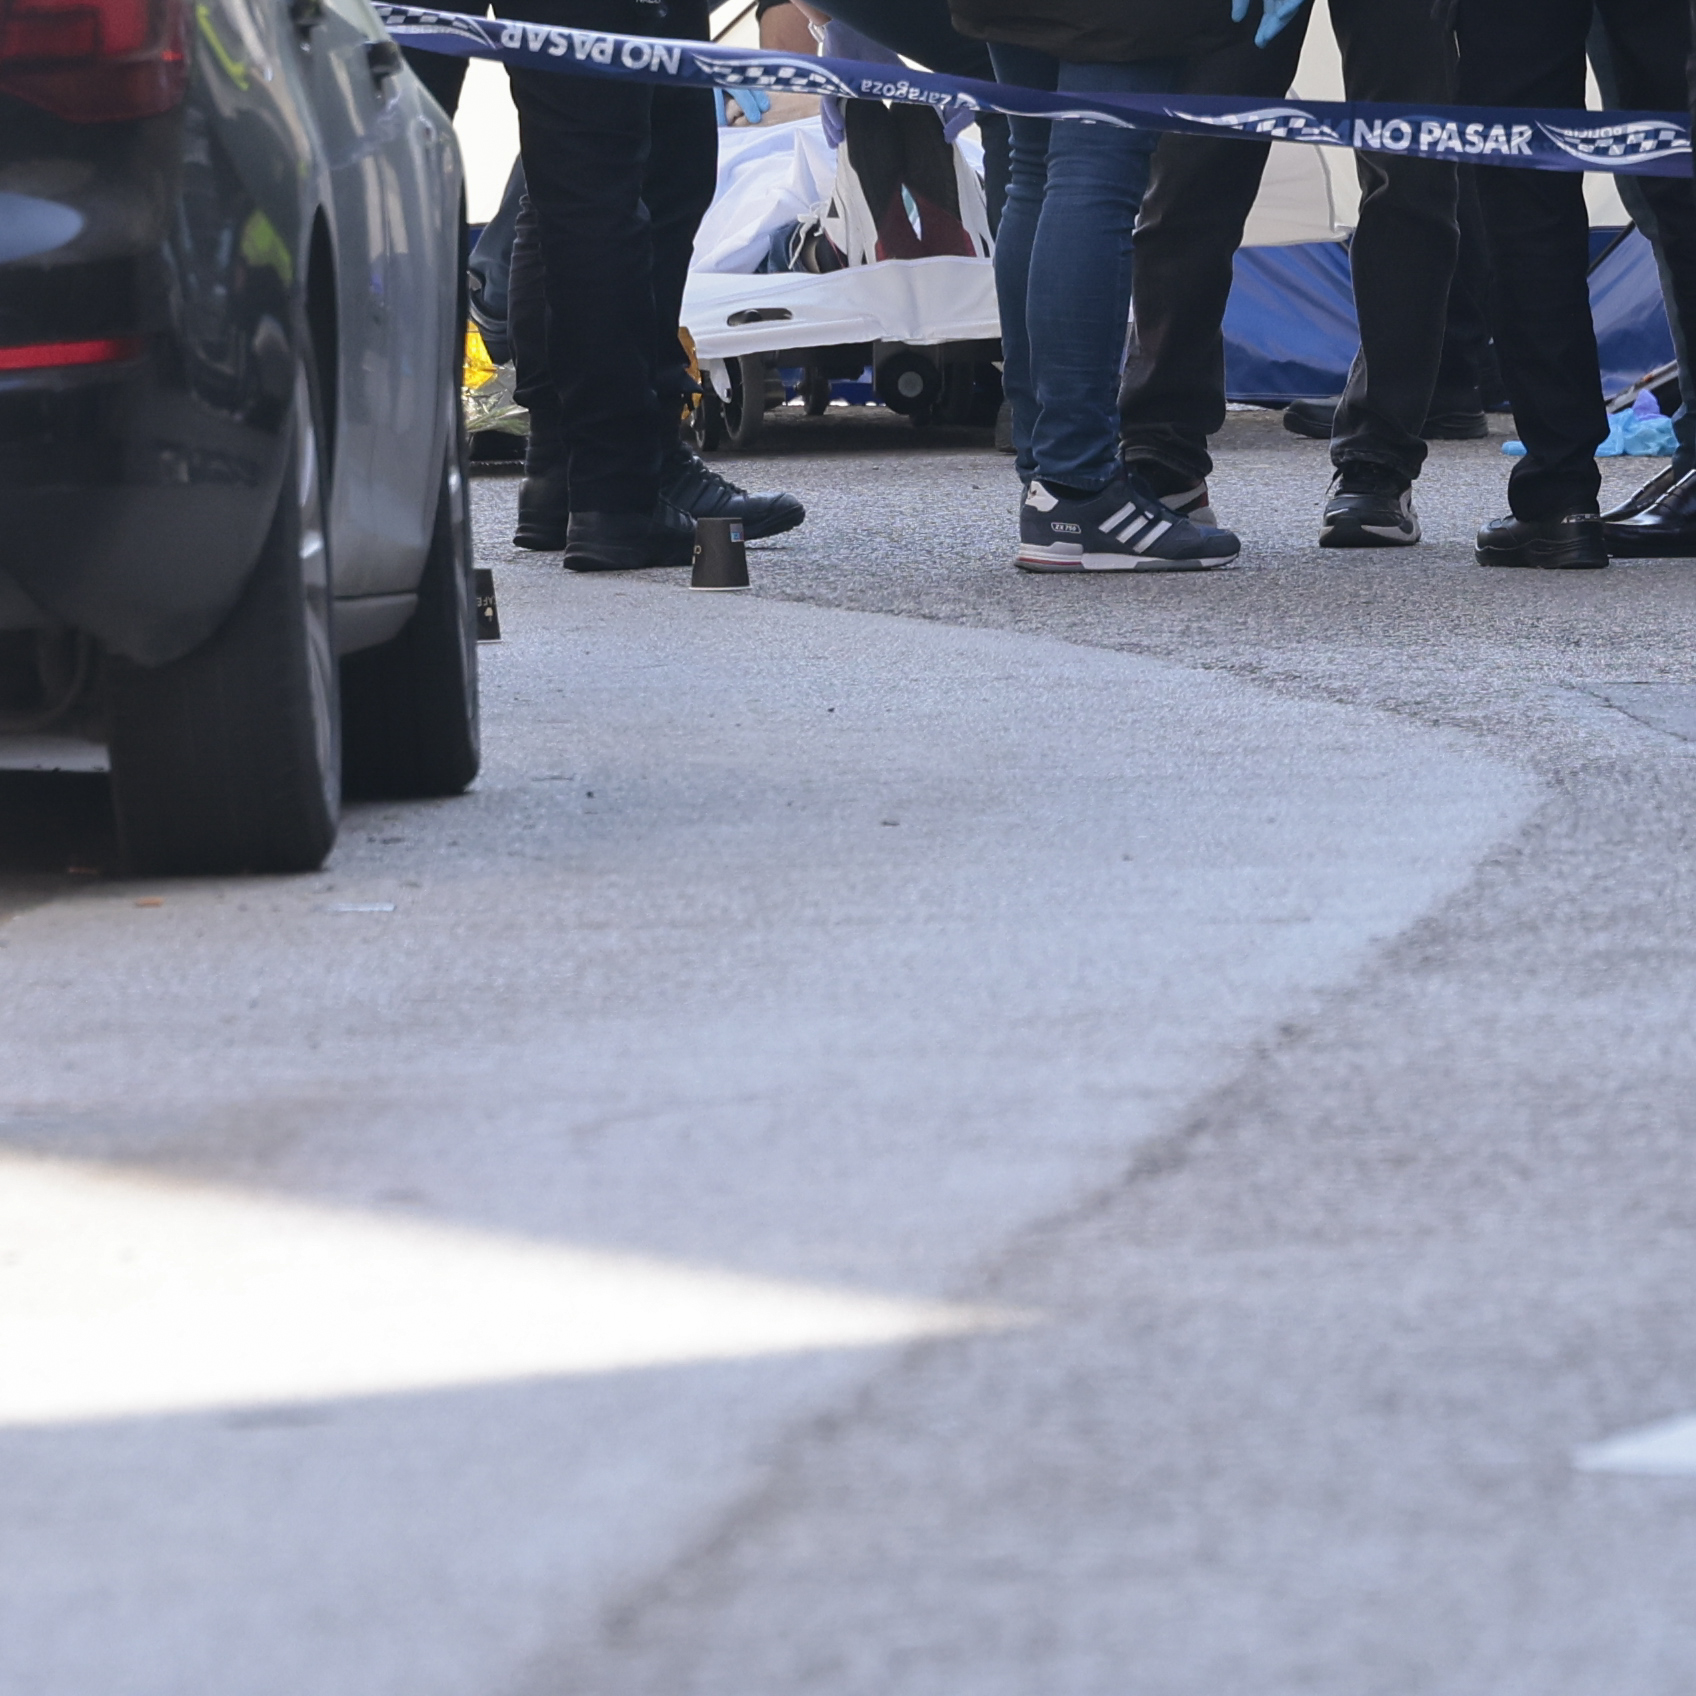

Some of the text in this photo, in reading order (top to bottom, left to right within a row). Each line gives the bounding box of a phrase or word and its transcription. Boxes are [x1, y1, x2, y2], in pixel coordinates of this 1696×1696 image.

[500, 22, 682, 74] NO PASAR
[1354, 118, 1533, 155] NO PASAR
